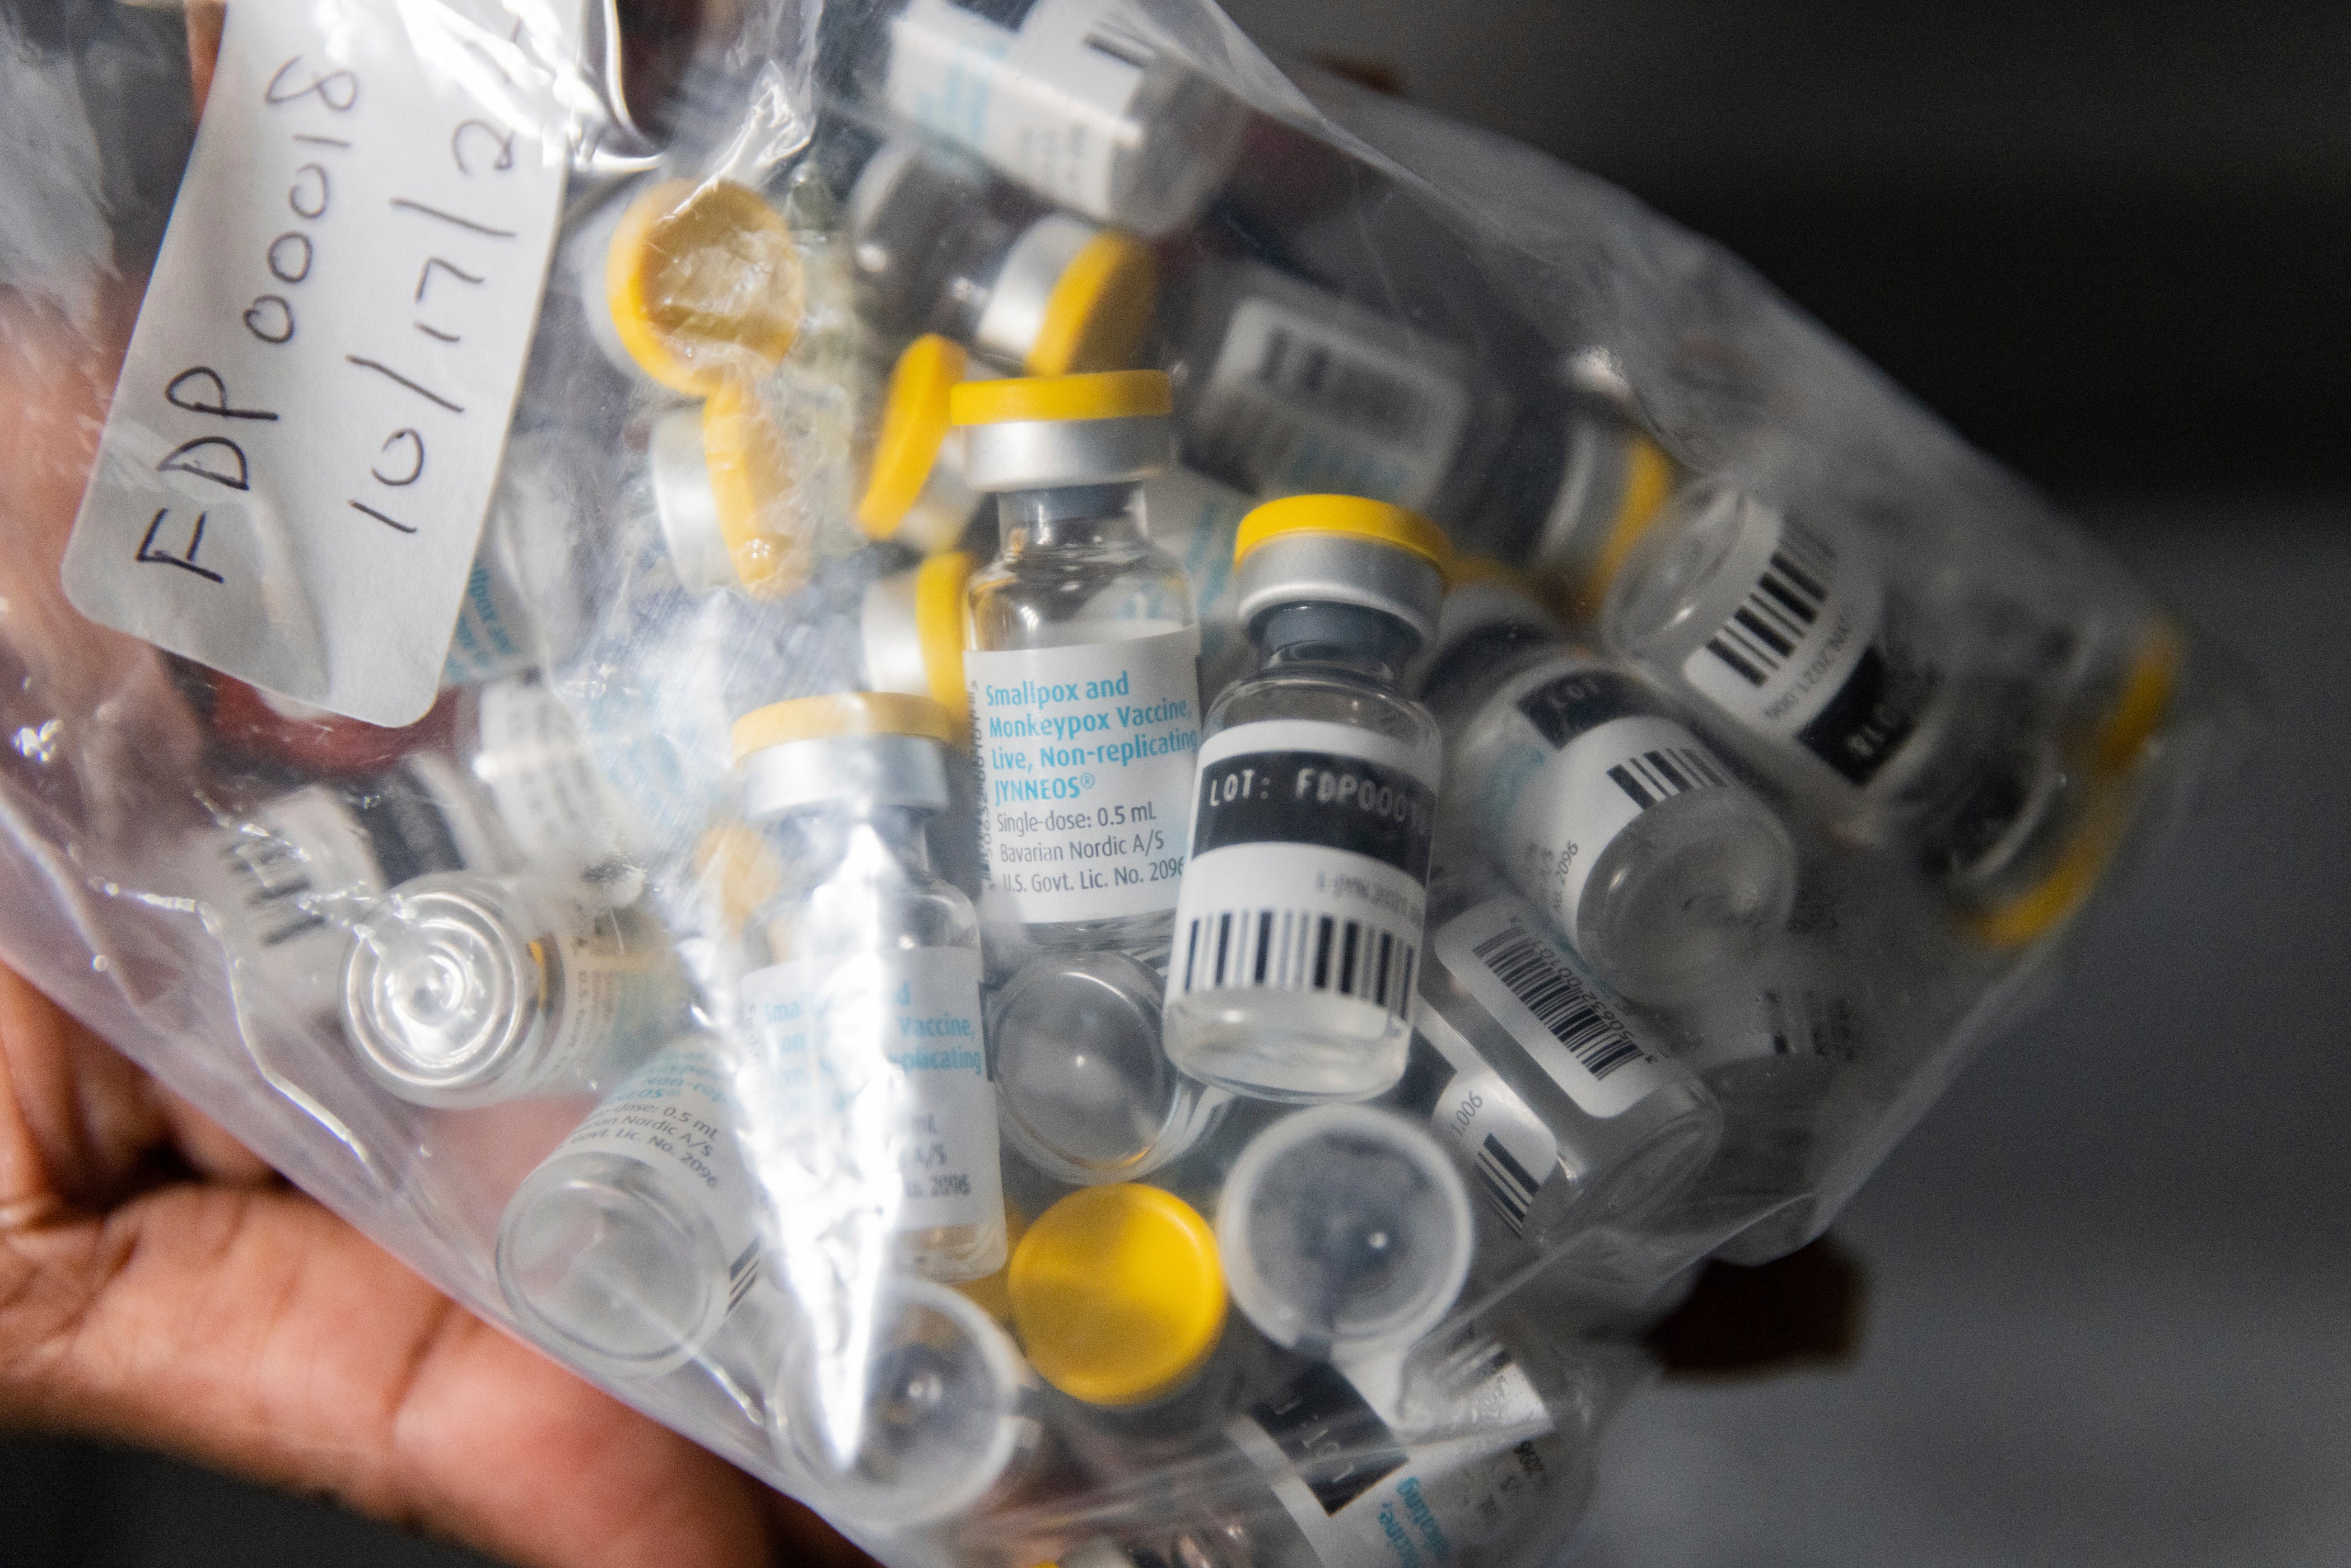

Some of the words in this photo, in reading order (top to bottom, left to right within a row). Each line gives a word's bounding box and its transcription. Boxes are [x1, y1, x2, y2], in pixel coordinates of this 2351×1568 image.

[134, 365, 279, 584] FDP
[242, 54, 358, 345] 00018
[346, 118, 518, 535] 10/17/2
[985, 680, 1080, 710] Smallpox
[1086, 670, 1130, 700] and
[989, 712, 1112, 740] Monkeypox
[1116, 697, 1193, 728] Vaccine,
[991, 746, 1033, 773] Live,
[1039, 728, 1198, 767] Non-replicating
[1210, 767, 1271, 807] LOT:
[997, 809, 1092, 837] Single-dose:
[1097, 804, 1126, 828] 0.5
[1130, 799, 1158, 823] mL
[1000, 841, 1064, 863] Bavarian
[1069, 835, 1128, 860] Nordic
[1132, 829, 1165, 857] A/S
[1555, 840, 1579, 885] 2096
[1002, 873, 1028, 893] U.S.
[1030, 871, 1075, 893] Govt.
[1079, 868, 1109, 890] Lic.
[1113, 865, 1145, 886] No.
[622, 1115, 679, 1136] Nordic
[678, 1132, 714, 1158] A/S
[663, 1107, 693, 1123] 0.5
[692, 1119, 719, 1143] mL
[647, 1135, 675, 1156] No.
[679, 1151, 720, 1189] 2096
